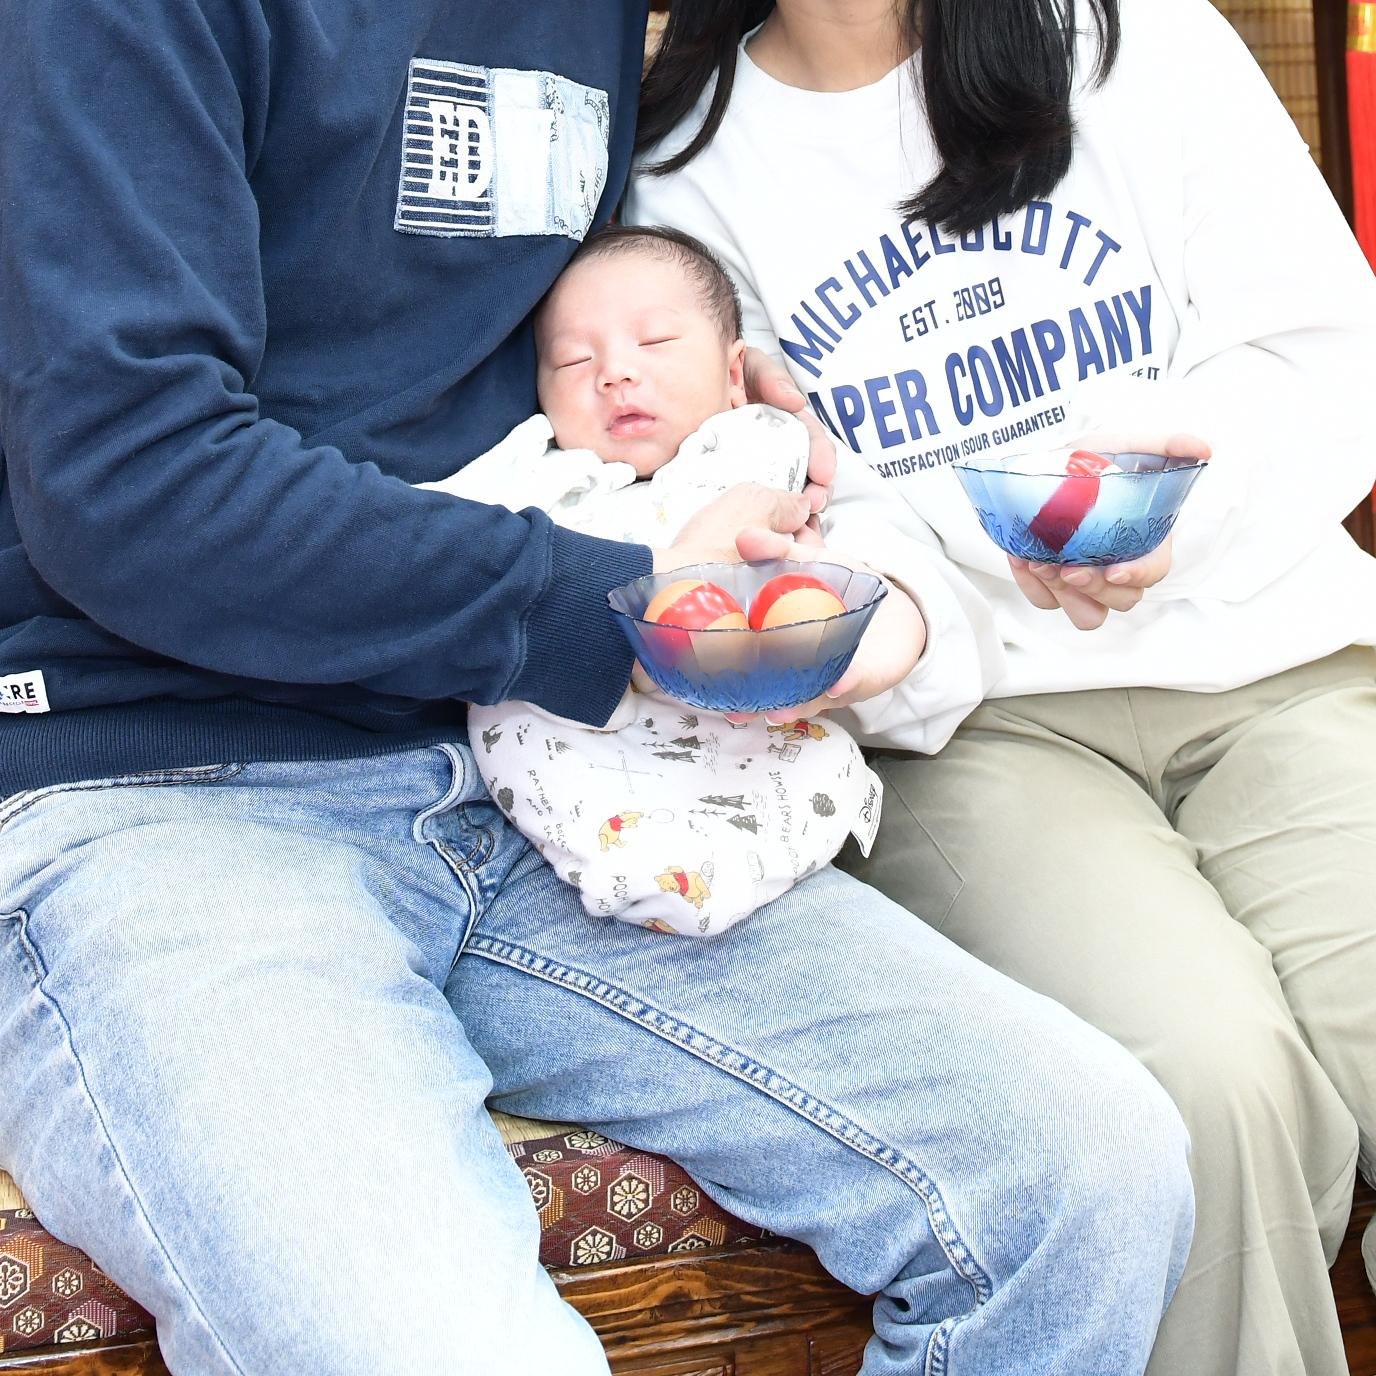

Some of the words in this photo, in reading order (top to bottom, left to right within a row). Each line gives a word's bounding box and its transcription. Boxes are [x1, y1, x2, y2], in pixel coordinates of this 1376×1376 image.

[945, 285, 1153, 426] COMPANY
[527, 769, 553, 814] RATHER
[779, 805, 792, 842] BEARS
